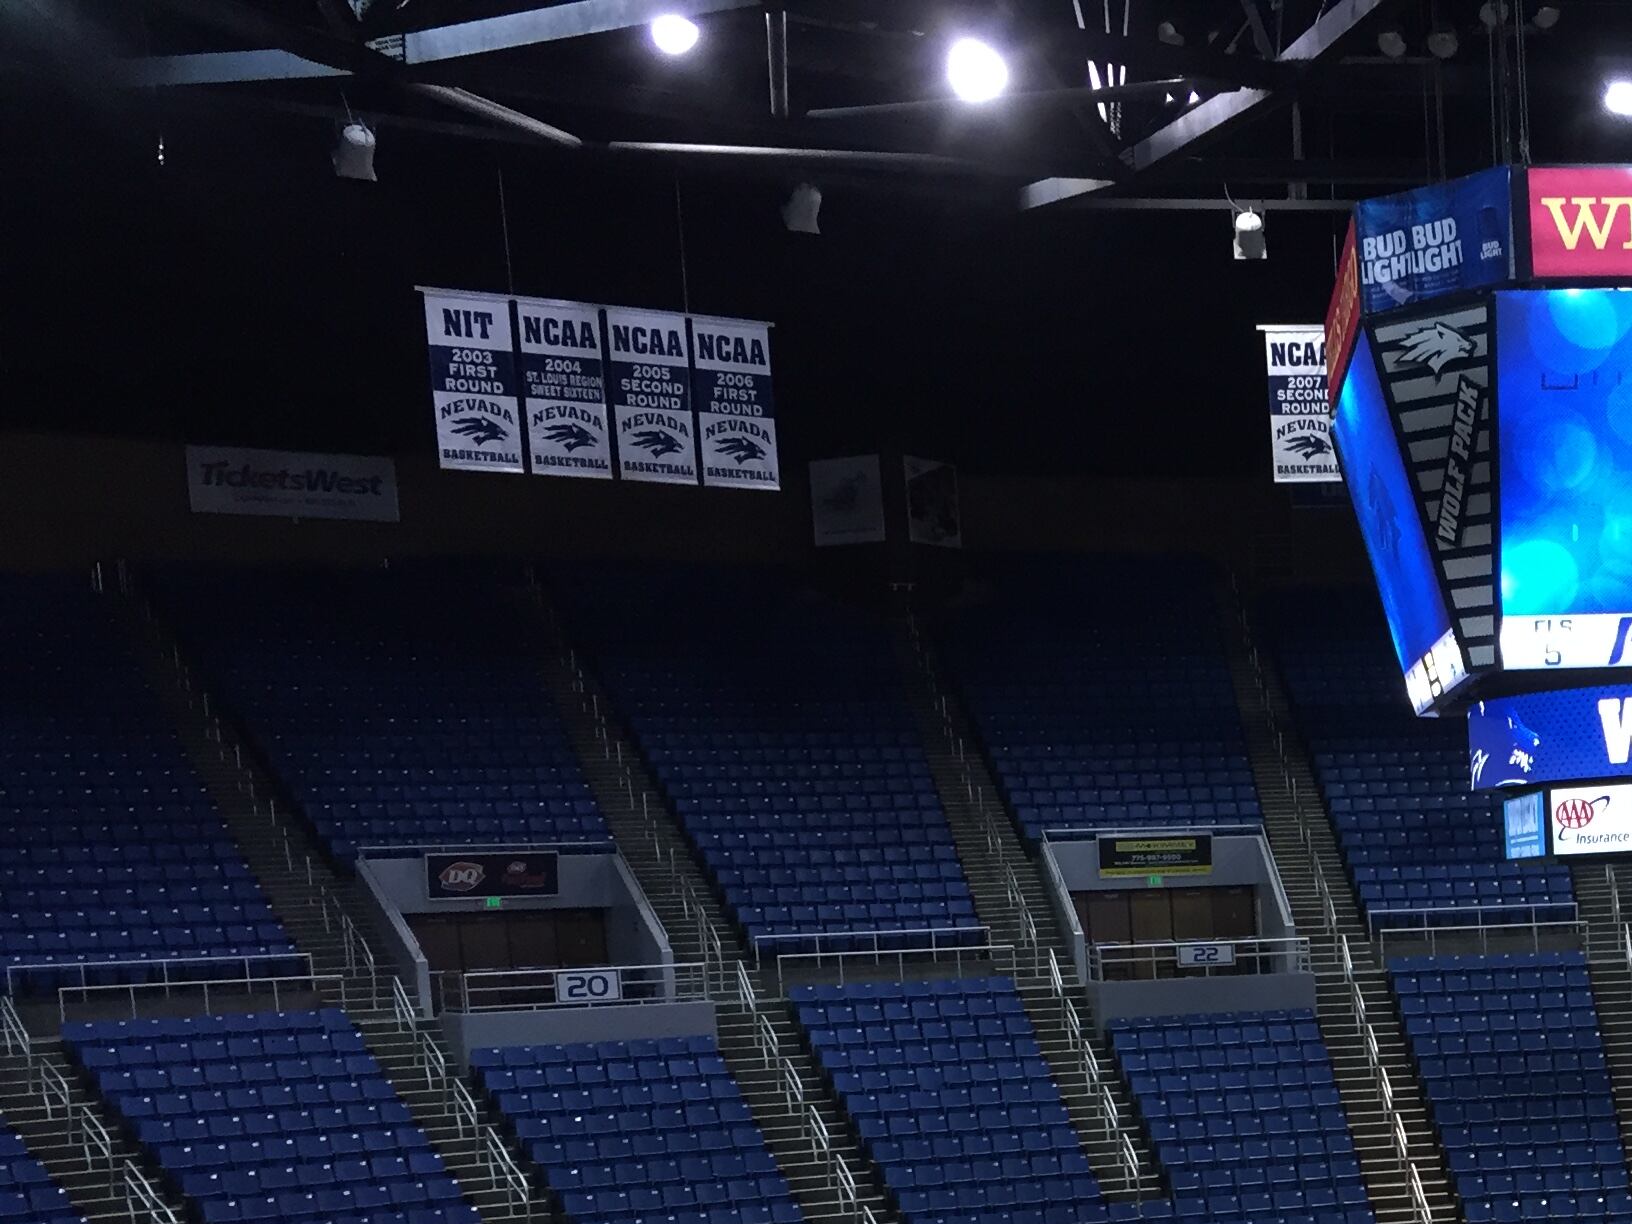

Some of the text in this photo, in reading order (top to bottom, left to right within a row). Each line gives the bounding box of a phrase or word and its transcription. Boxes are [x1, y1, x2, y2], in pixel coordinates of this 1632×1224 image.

[1363, 217, 1457, 261] BUD BUD
[1482, 241, 1500, 251] BUD
[1361, 251, 1412, 285] LIGHT
[1412, 239, 1464, 275] LIGHT
[1480, 248, 1502, 260] LIGHT
[442, 308, 493, 340] NIT
[523, 315, 597, 349] NCAA
[612, 325, 684, 357] NCAA
[452, 349, 493, 365] 2003
[697, 333, 767, 366] NCAA
[449, 363, 497, 378] FIRST
[545, 359, 582, 374] 2004
[632, 365, 671, 379] 2005
[445, 378, 504, 394] ROUND
[621, 378, 684, 395] SECOND
[717, 373, 754, 388] 2006
[1287, 376, 1322, 389] 2007
[626, 394, 681, 409] ROUND
[713, 387, 757, 401] FIRST
[440, 399, 514, 425] NEVADA
[710, 401, 763, 416] ROUND
[1282, 402, 1330, 414] ROUND
[533, 405, 604, 431] NEVADA
[622, 413, 689, 438] NEVADA
[705, 419, 772, 445] NEVADA
[1276, 419, 1328, 440] NEVAD
[443, 449, 519, 464] BASKETBALL
[535, 455, 608, 470] BASKETBALL
[1438, 380, 1479, 542] WOLF PACK
[624, 461, 694, 476] BASKETBALL
[707, 467, 776, 482] BASKETBALL
[200, 460, 383, 496] TicketsWest
[1559, 798, 1592, 828] AAA
[1576, 832, 1630, 845] Insurance
[447, 867, 480, 885] DQ
[1193, 947, 1219, 962] 22
[566, 975, 609, 998] 20
